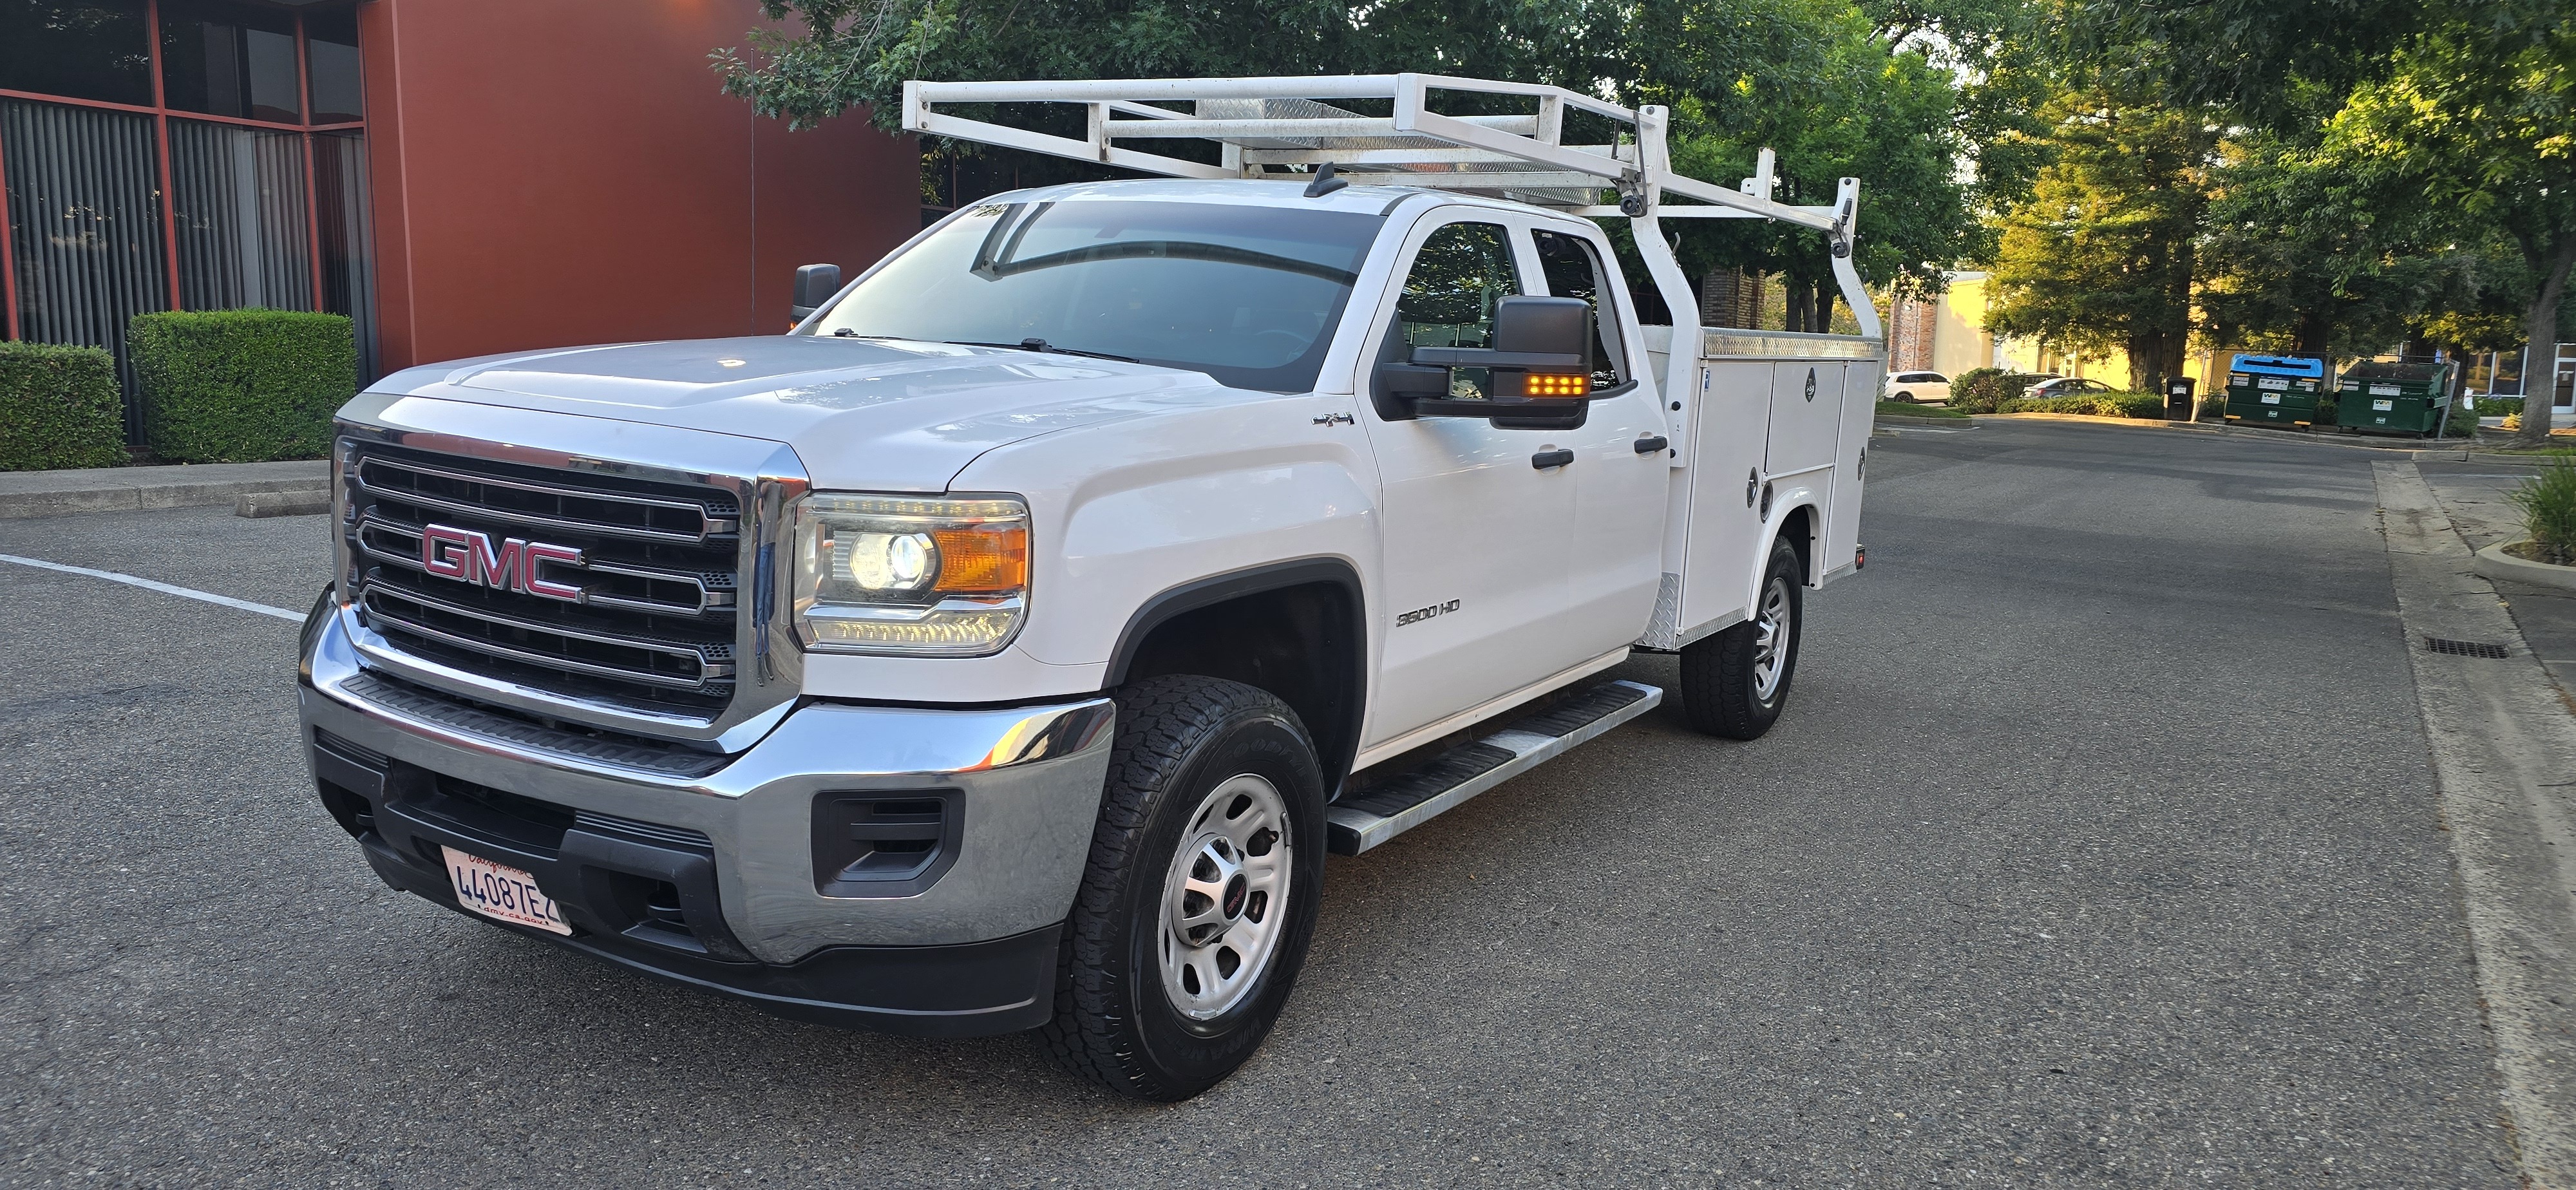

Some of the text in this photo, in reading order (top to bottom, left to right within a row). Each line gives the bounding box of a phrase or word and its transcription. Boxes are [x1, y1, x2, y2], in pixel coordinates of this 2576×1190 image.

[422, 524, 582, 603] GMC
[1396, 599, 1460, 627] 3500 HD
[1226, 882, 1246, 913] GMC
